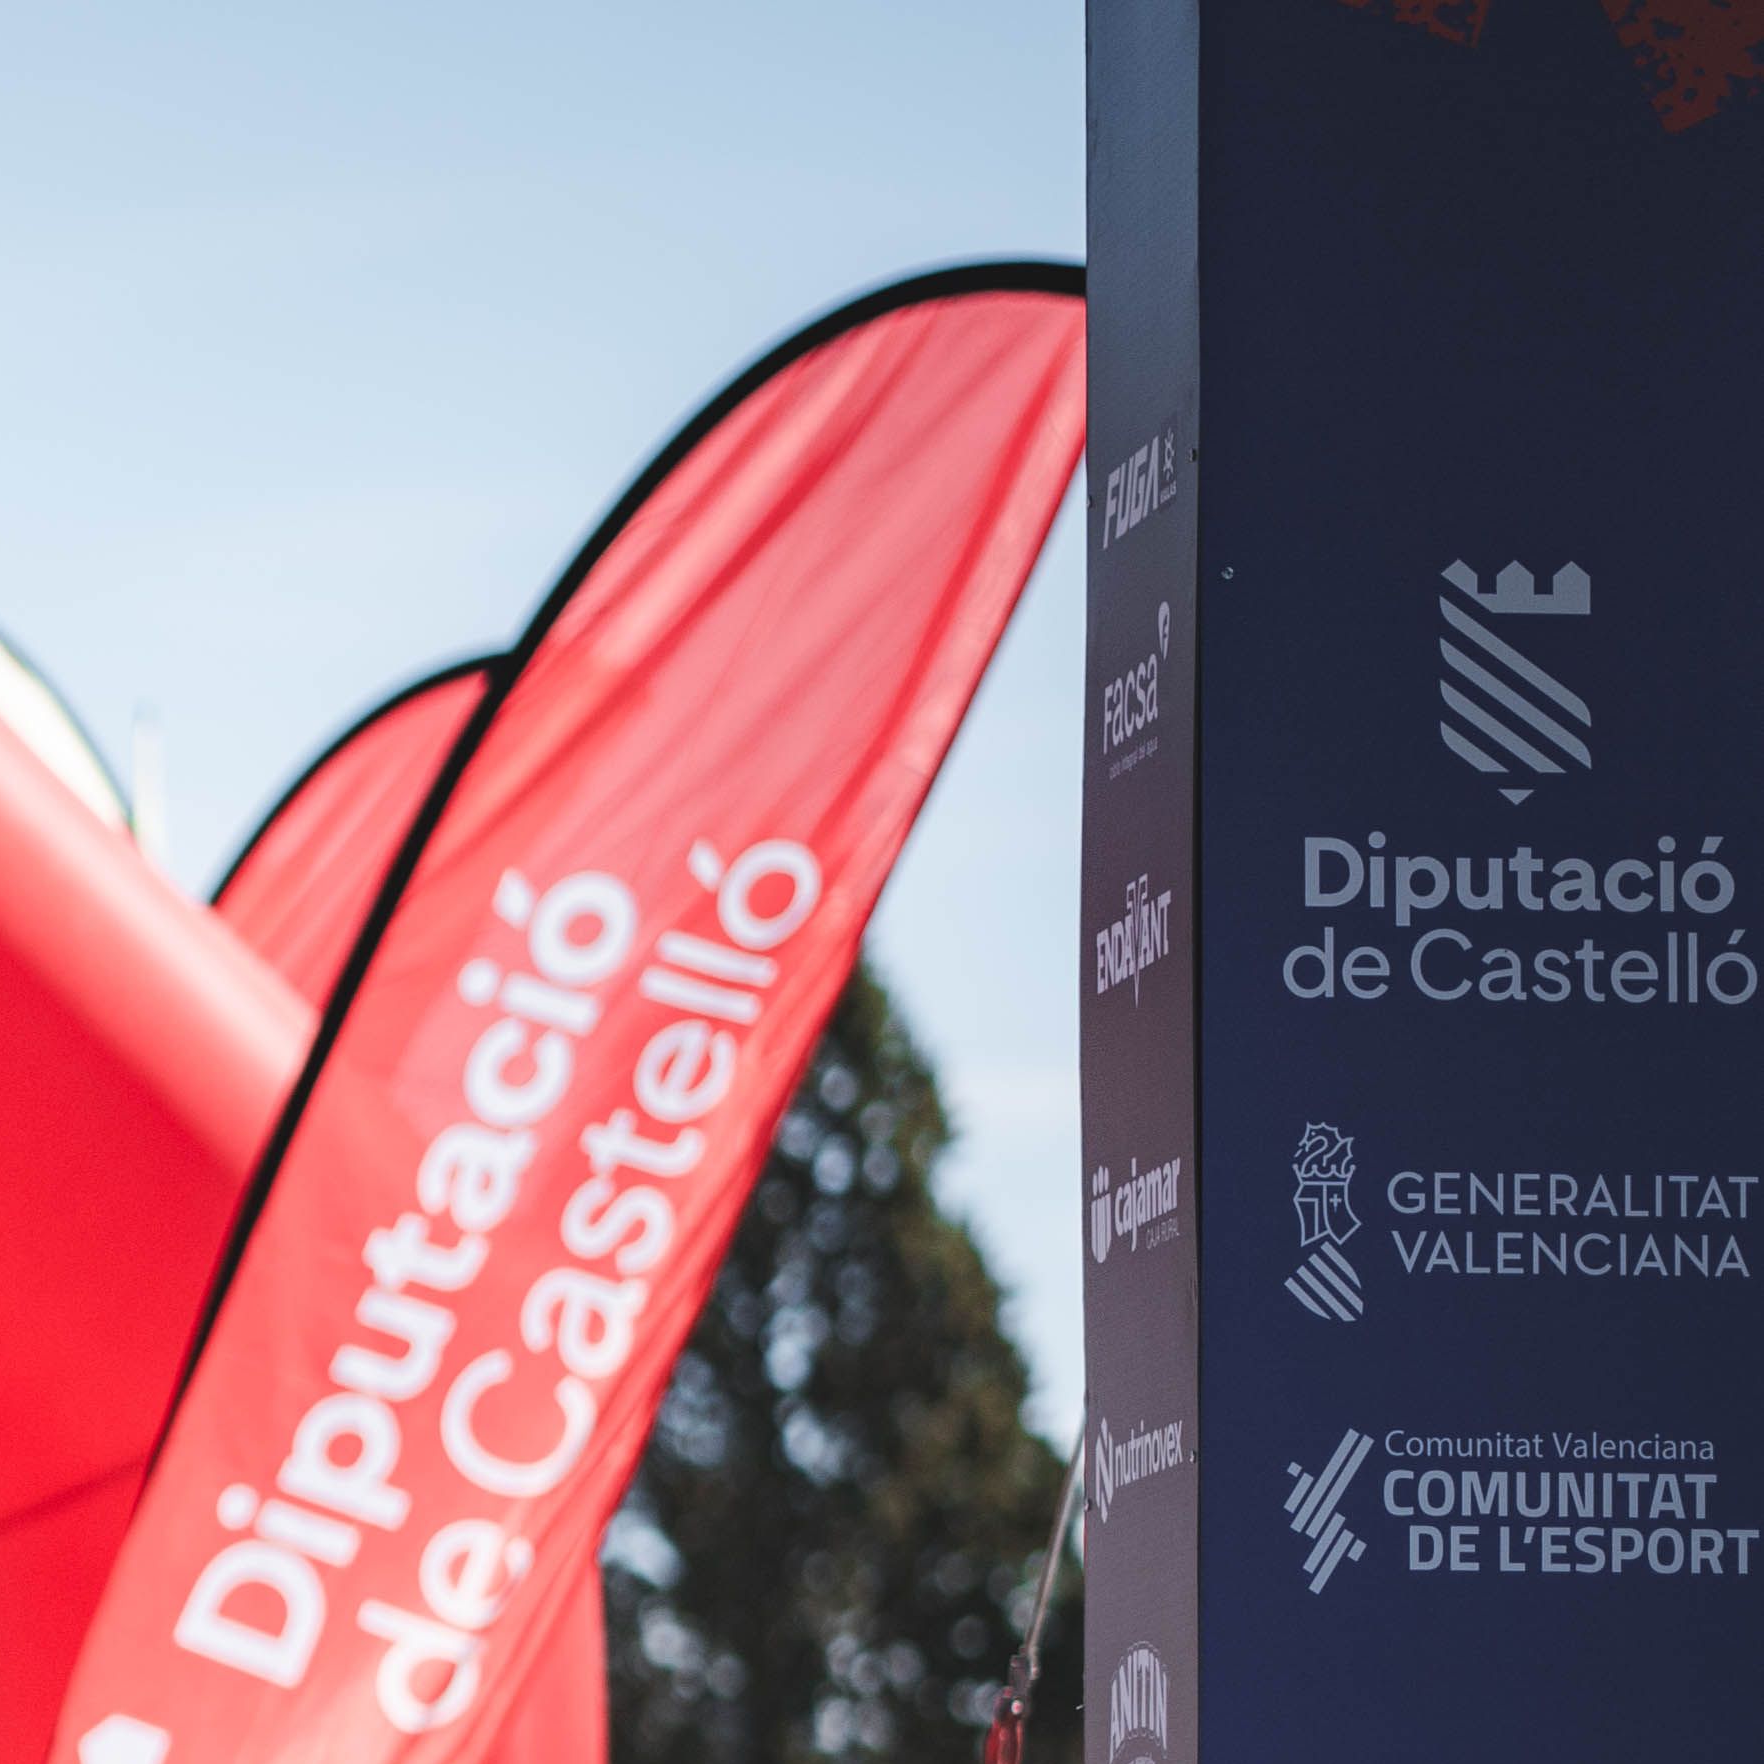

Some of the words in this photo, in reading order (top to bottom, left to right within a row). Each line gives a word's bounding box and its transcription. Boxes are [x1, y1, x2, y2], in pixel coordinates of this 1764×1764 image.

[1103, 436, 1159, 549] FUGA
[1304, 831, 1735, 927] Diputació
[1096, 873, 1171, 1009] ENDAVANT
[1283, 927, 1390, 999] de
[1411, 928, 1758, 1005] Castelló
[440, 840, 823, 1499] Castelló
[1115, 1157, 1180, 1252] cajamar
[1387, 1171, 1760, 1219] GENERALITAT
[172, 869, 636, 1688] Diputació
[1392, 1230, 1751, 1278] VALENCIANA
[1114, 1420, 1182, 1490] nutrinovex
[1384, 1429, 1543, 1460] Comunitat
[1551, 1431, 1715, 1461] Valenciana
[1383, 1469, 1717, 1519] COMUNITAT
[1409, 1525, 1479, 1572] DE
[1499, 1527, 1759, 1575] L'ESPORT
[358, 1518, 535, 1734] de
